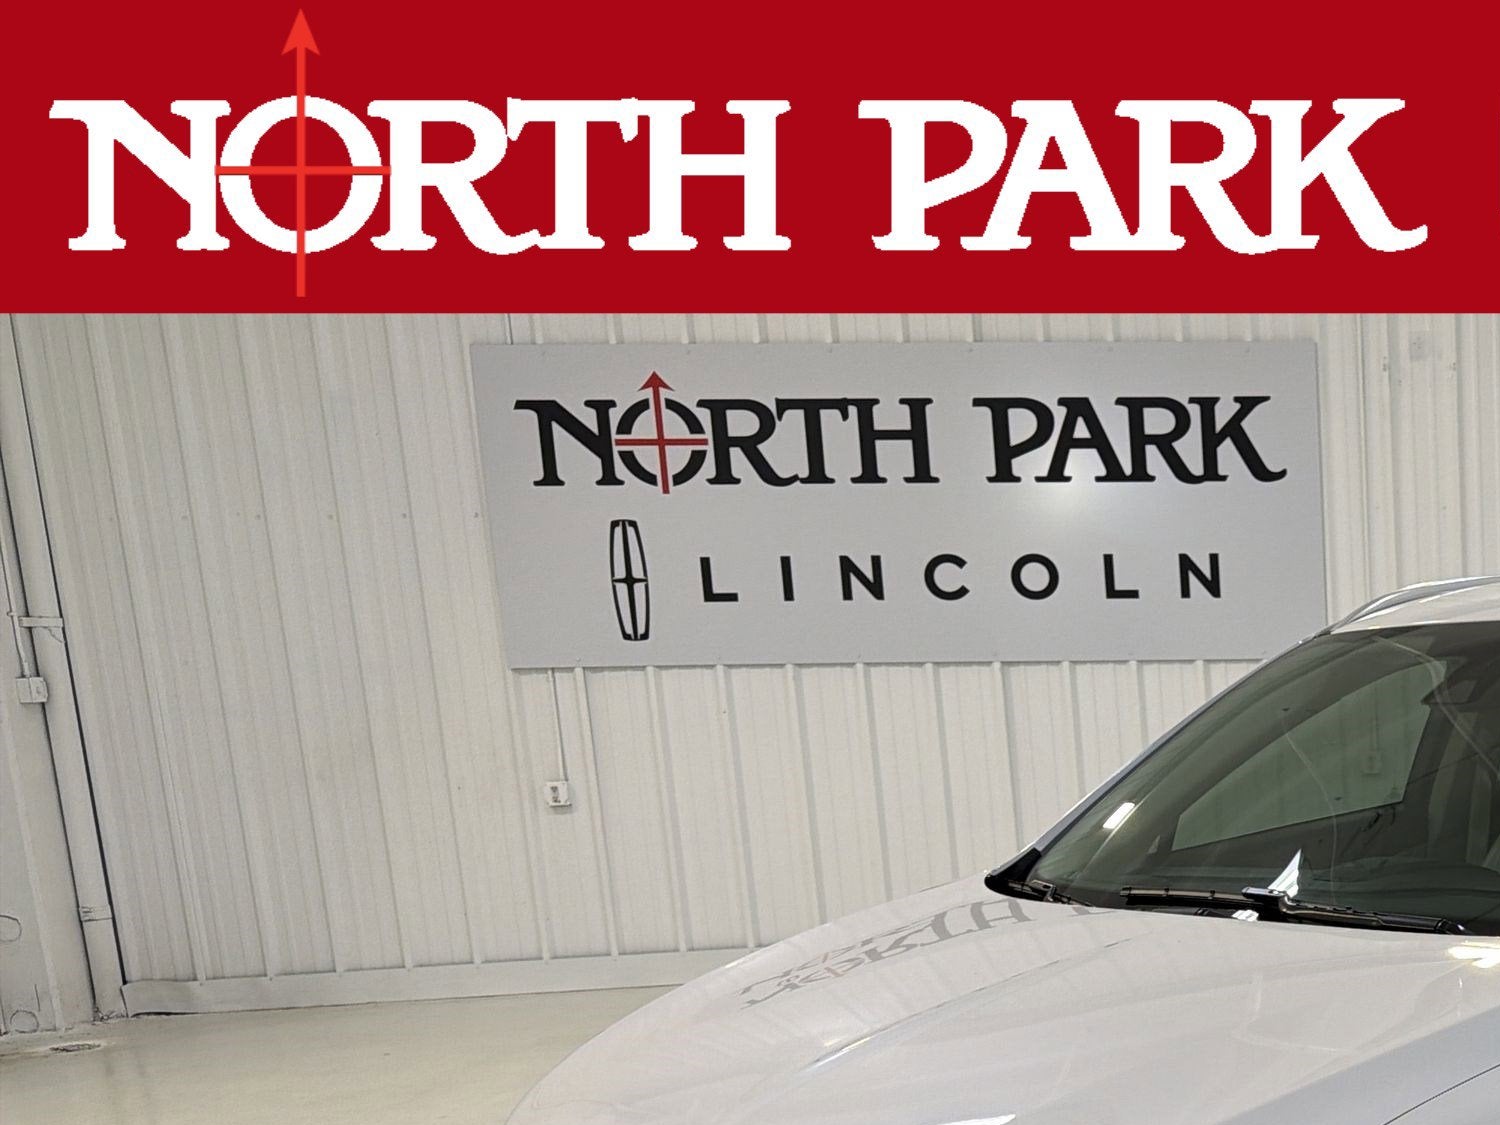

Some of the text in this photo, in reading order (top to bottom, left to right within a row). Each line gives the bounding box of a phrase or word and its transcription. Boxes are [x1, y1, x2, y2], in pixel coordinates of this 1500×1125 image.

[513, 395, 1287, 488] NORTH PARK
[699, 552, 1222, 603] LINCOLN
